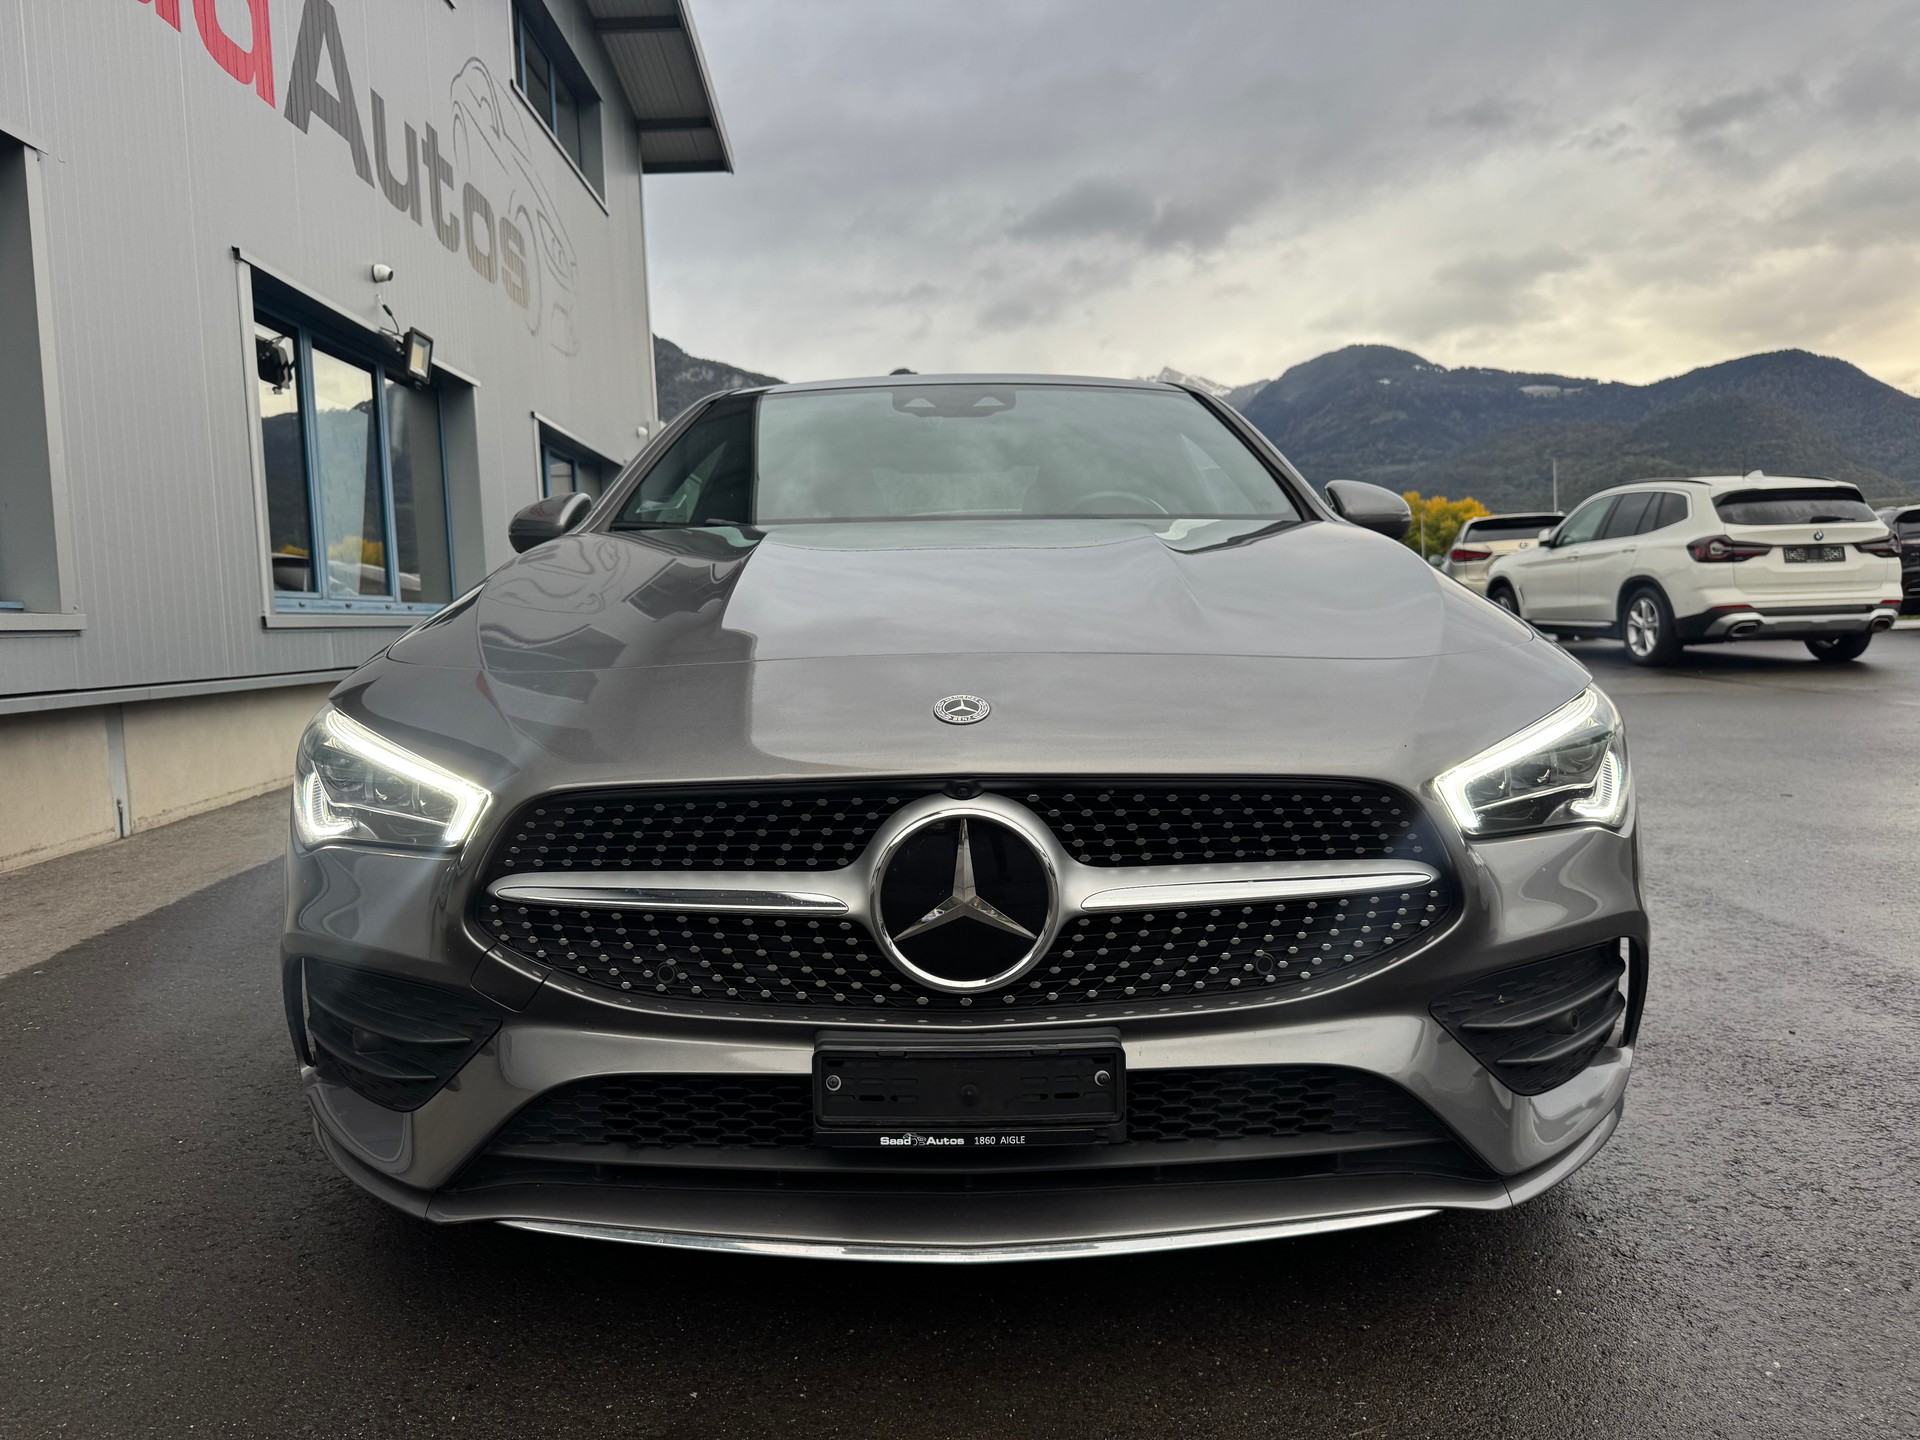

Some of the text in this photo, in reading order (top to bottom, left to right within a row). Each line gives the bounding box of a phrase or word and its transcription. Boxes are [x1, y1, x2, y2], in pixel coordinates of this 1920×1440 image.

[880, 1135, 1026, 1146] Saad Autos 1860 AIGLE
